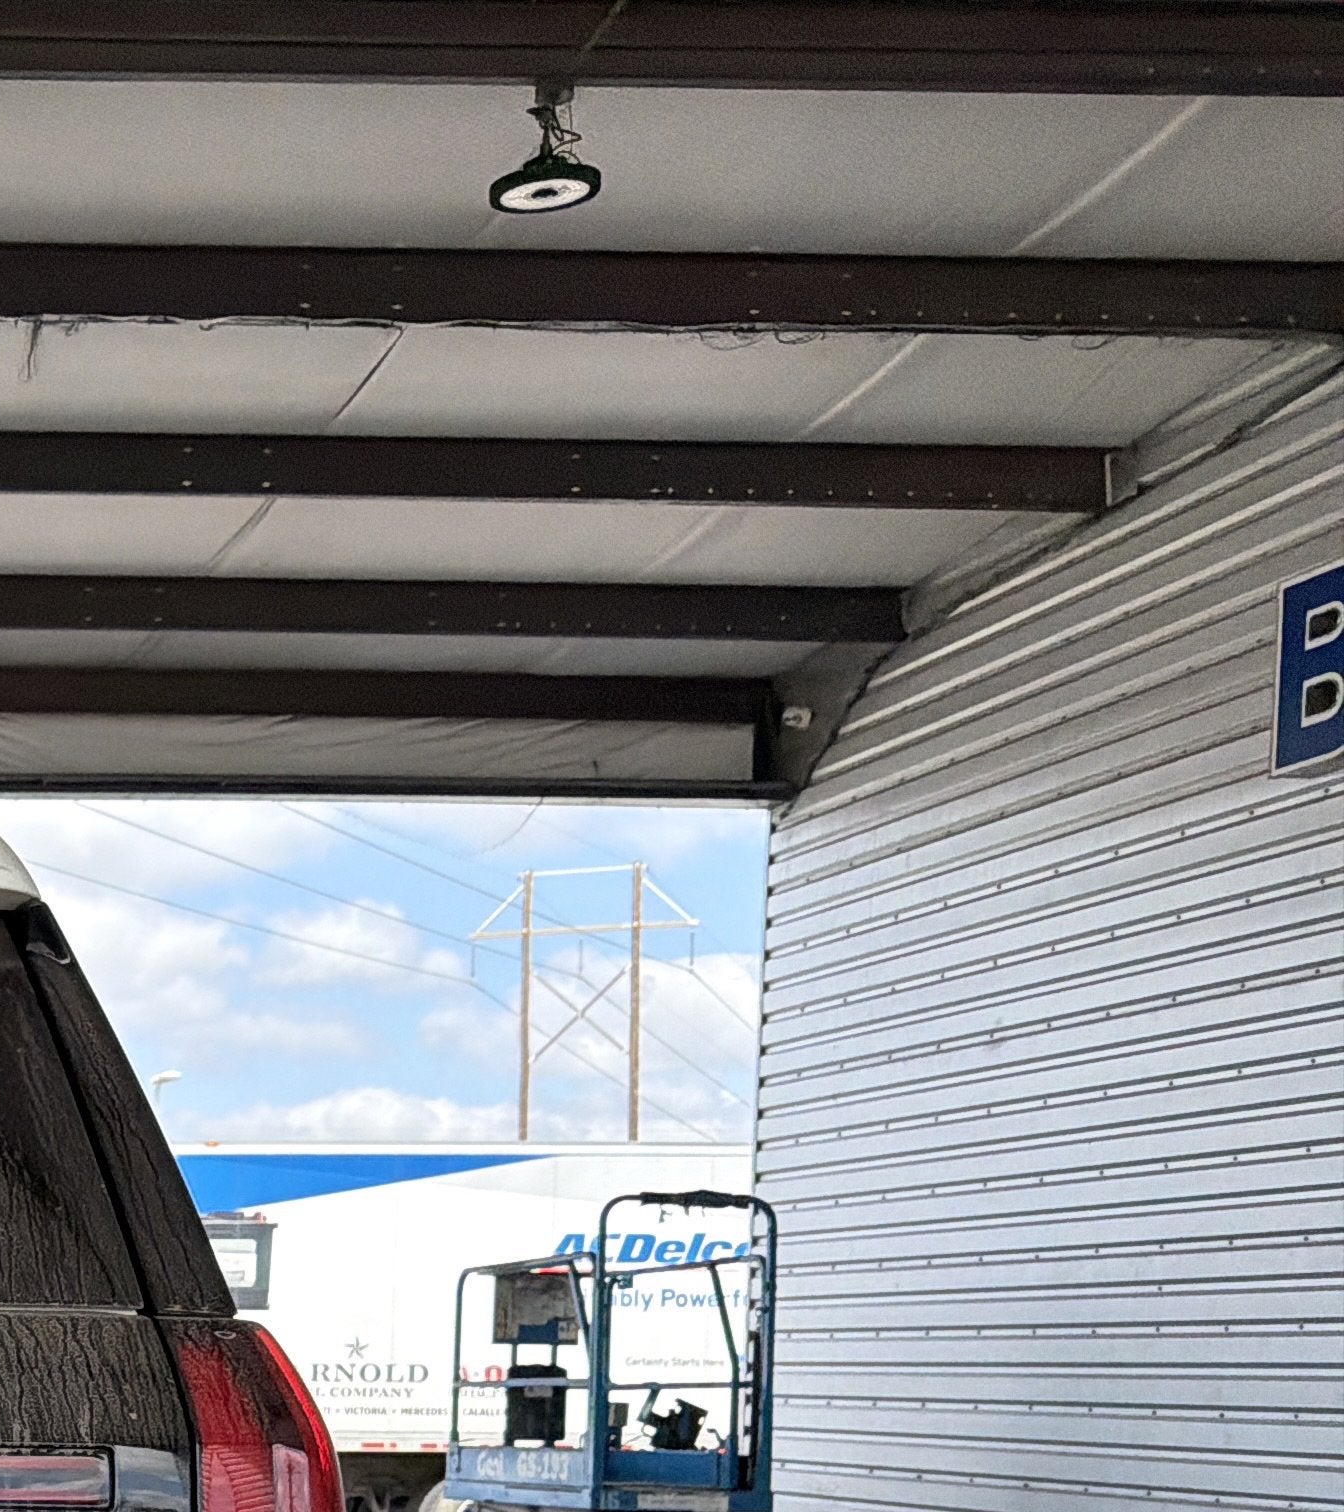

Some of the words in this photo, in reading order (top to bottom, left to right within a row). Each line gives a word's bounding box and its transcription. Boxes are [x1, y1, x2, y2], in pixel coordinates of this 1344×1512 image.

[311, 1363, 429, 1384] RNOLD
[329, 1387, 414, 1398] COMPANY
[344, 1407, 387, 1416] VICTORIA
